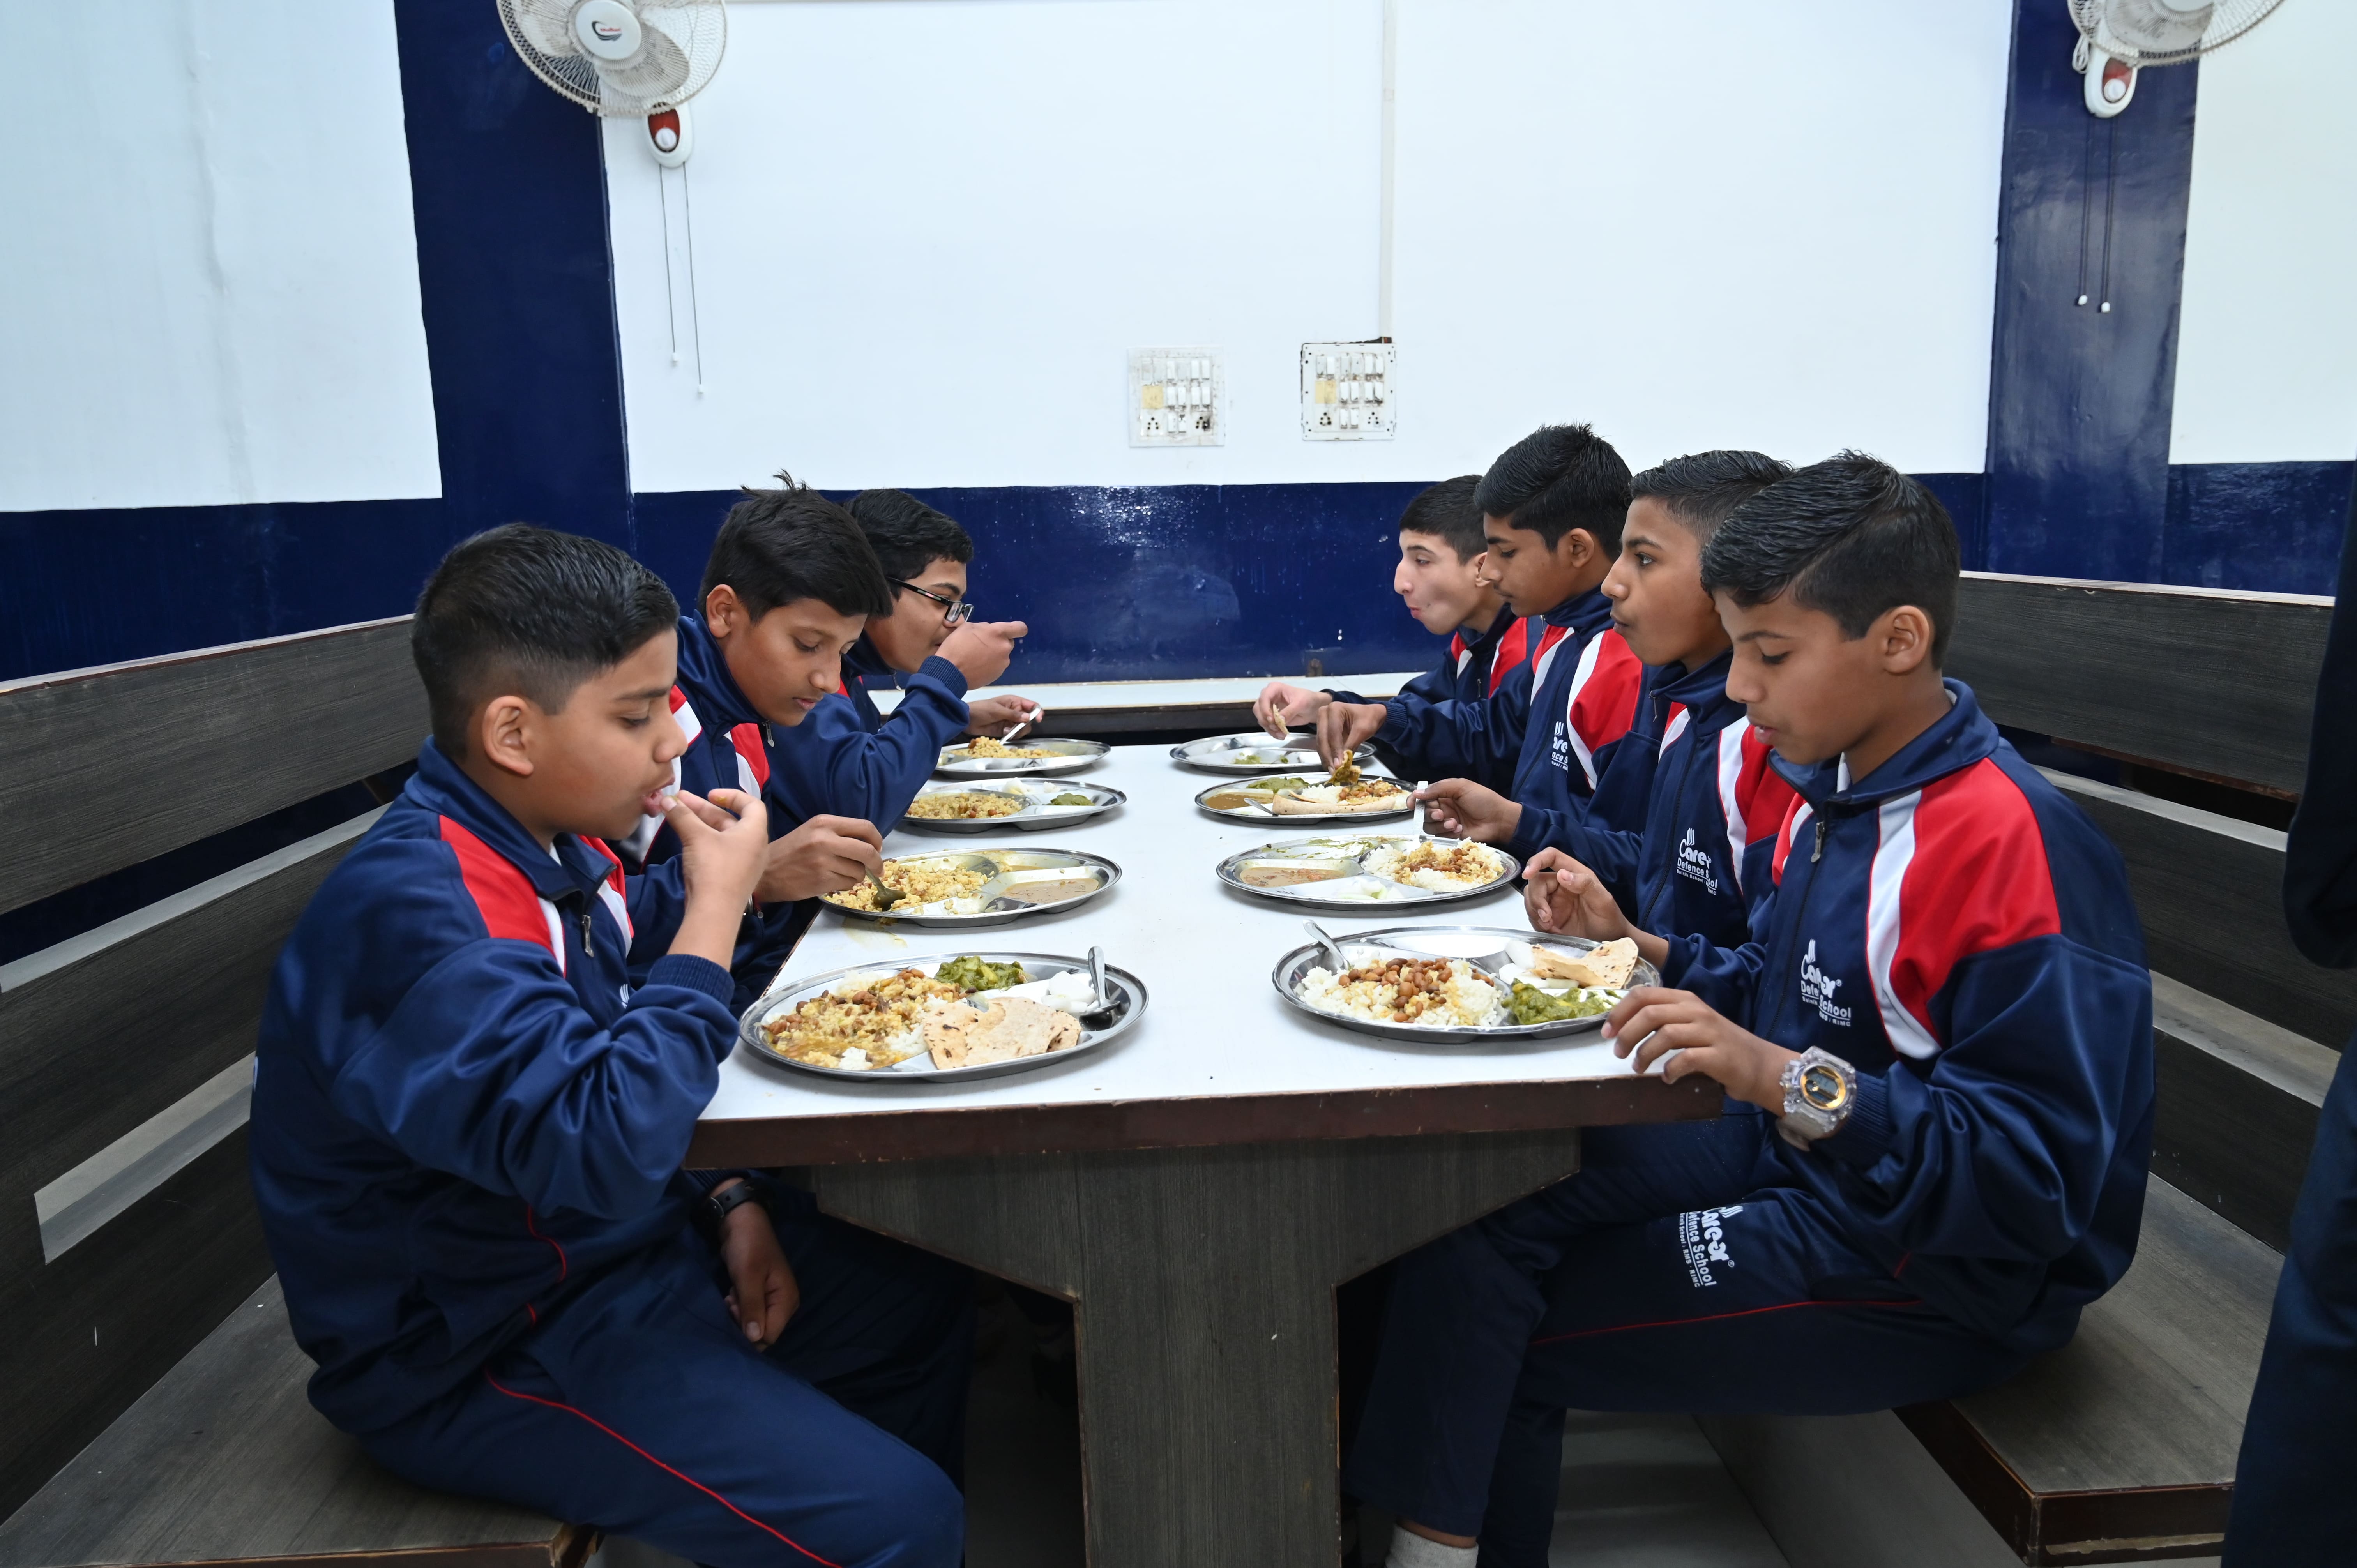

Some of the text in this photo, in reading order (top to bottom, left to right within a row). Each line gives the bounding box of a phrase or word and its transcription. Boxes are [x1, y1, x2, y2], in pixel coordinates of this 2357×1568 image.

[1677, 857, 1704, 876] Defence
[1677, 869, 1688, 877] Sainik
[1689, 874, 1703, 883] School
[1802, 996, 1818, 1005] Sainik
[1819, 995, 1851, 1018] School
[1683, 1249, 1692, 1264] RMS
[1689, 1269, 1700, 1287] RIMC
[1693, 1244, 1717, 1286] School
